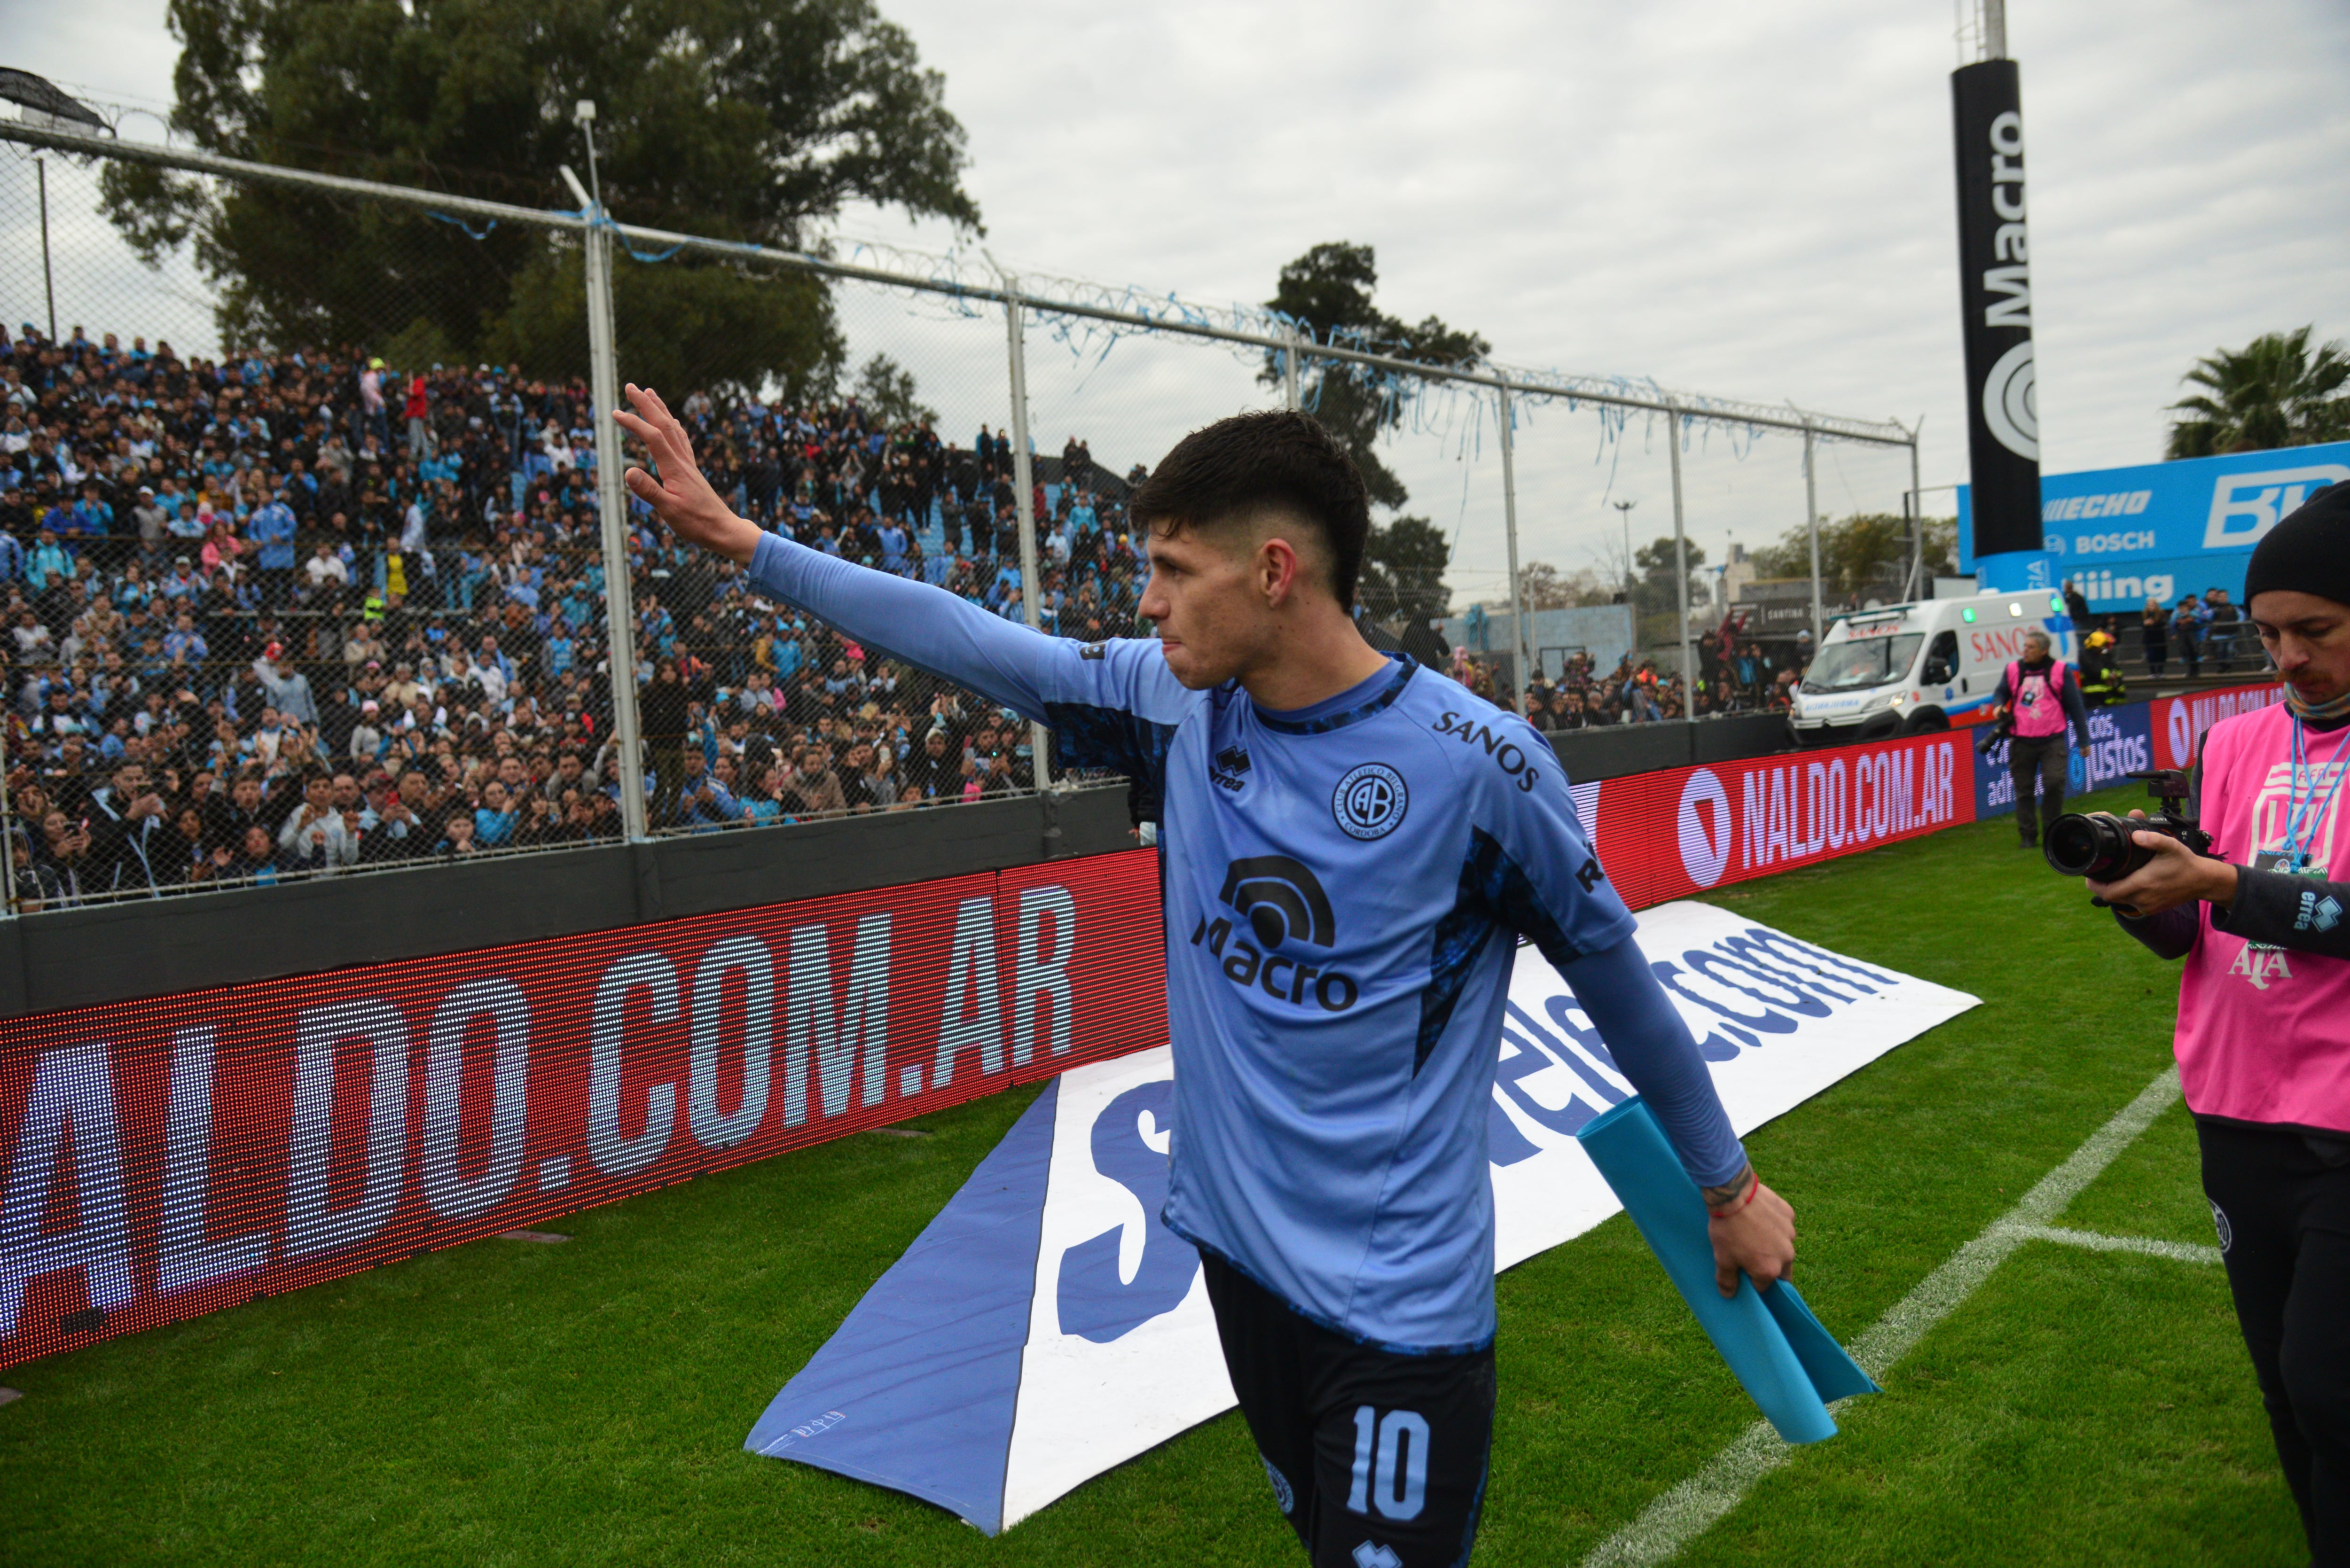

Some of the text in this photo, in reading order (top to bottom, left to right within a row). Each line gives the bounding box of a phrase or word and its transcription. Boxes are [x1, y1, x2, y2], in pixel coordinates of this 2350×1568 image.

[1983, 110, 2032, 328] Macro
[2062, 490, 2152, 521] ECHO
[2075, 530, 2154, 554] BOSCH
[1971, 625, 2039, 663] SANO
[1432, 711, 1539, 792] SANOS
[1345, 766, 1384, 787] ATLETICO
[1386, 772, 1403, 820] BELGRANO
[1336, 788, 1346, 813] CLUB
[1742, 741, 1954, 870] NALDO.COM.AR
[1344, 822, 1386, 837] CORDOBA
[1190, 912, 1358, 1012] Macro
[1347, 1405, 1430, 1521] 10
